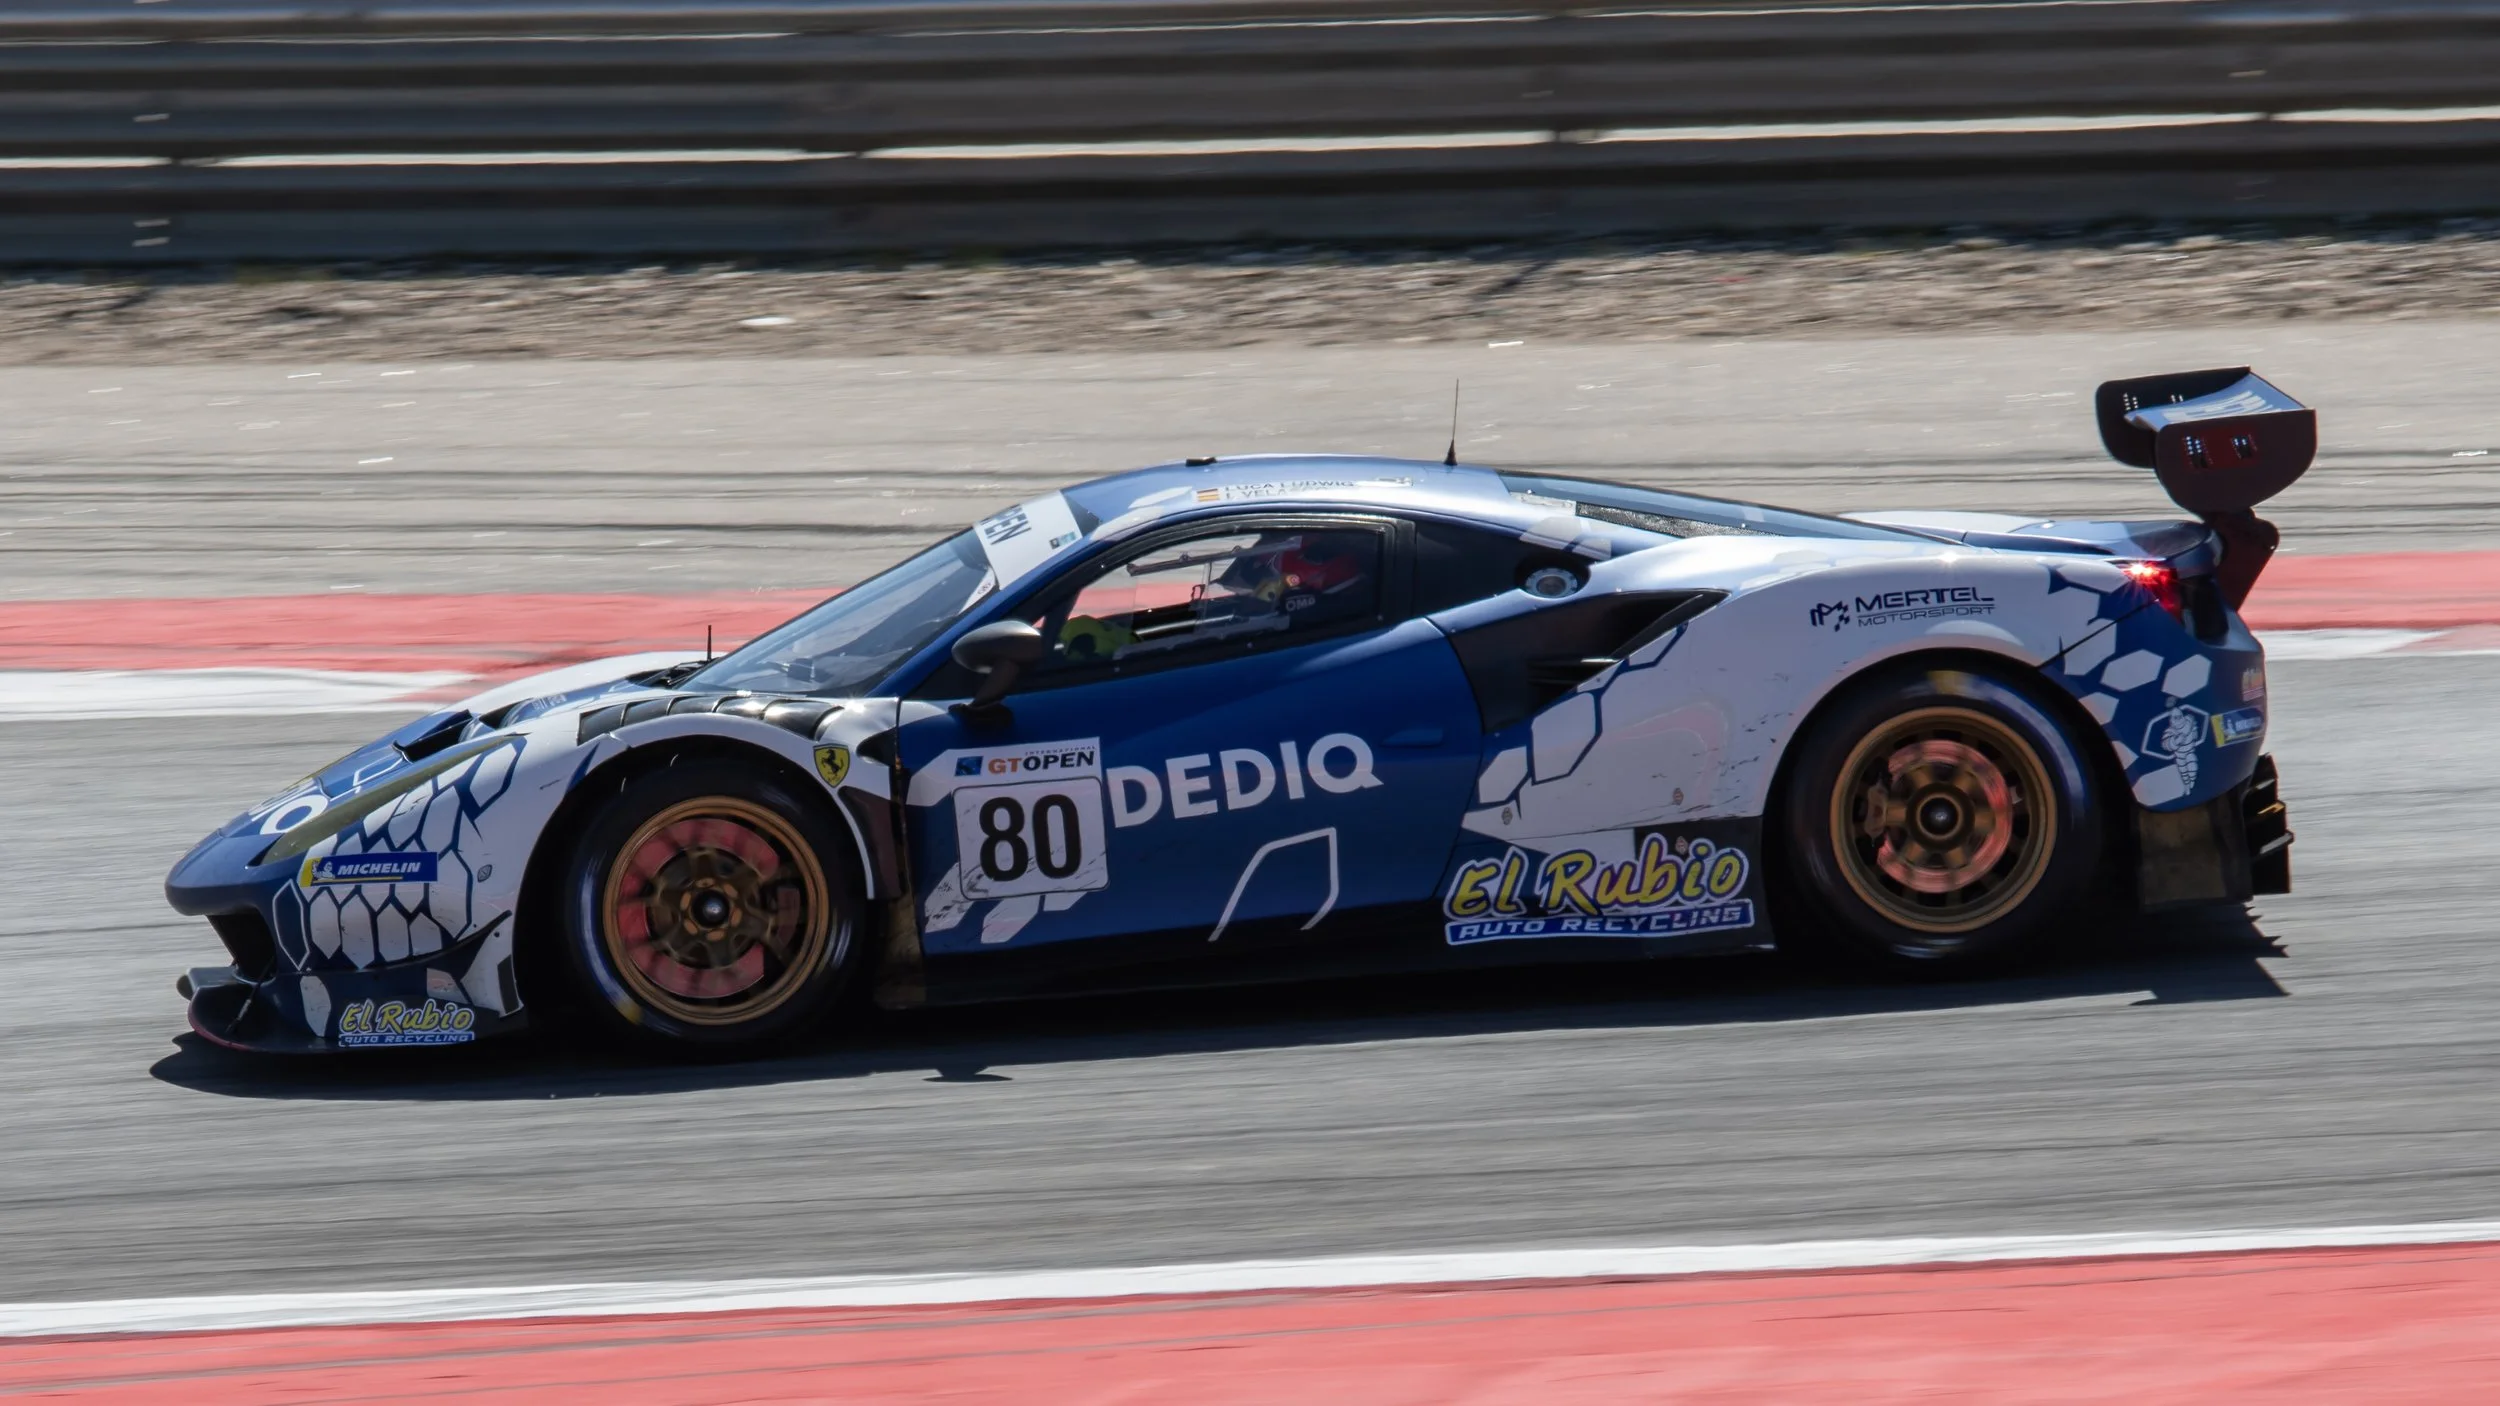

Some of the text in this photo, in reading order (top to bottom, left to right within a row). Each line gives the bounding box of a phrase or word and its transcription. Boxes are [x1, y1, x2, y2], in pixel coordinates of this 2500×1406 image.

[1225, 482, 1274, 491] LUCA
[1855, 587, 1995, 612] MERTEL
[1858, 606, 1996, 627] MOTORSPORT
[1025, 746, 1096, 756] INTERNATIONAL
[1106, 732, 1384, 828] DEDIQ
[978, 794, 1082, 882] 80
[337, 862, 421, 876] MICHELIN
[1543, 838, 1744, 917] Rubio
[1458, 907, 1742, 940] AUTO RECYCLING
[376, 1000, 474, 1035] Rubio
[345, 1034, 468, 1044] AUTO RECYCLING
